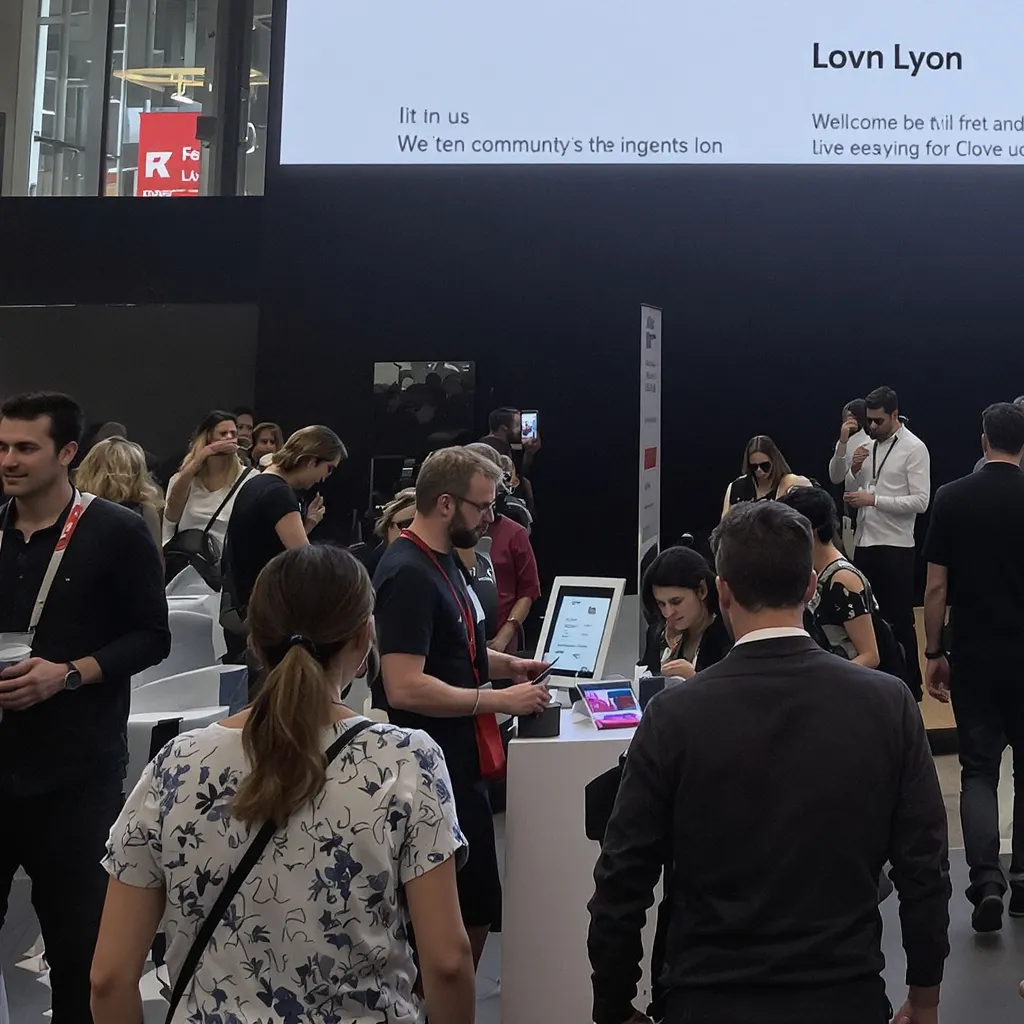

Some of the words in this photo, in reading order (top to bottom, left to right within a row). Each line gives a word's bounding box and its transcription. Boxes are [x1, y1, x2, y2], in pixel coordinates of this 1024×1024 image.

[812, 42, 885, 69] Lovn
[893, 43, 963, 77] Lyon
[424, 109, 440, 124] in
[448, 111, 470, 125] us
[812, 113, 898, 130] Wellcome
[904, 114, 925, 131] be
[959, 115, 989, 132] fret
[993, 116, 1024, 132] and
[398, 135, 428, 153] We
[588, 136, 615, 153] the
[621, 136, 689, 158] ingents
[926, 140, 951, 157] for
[956, 141, 1003, 157] Clove
